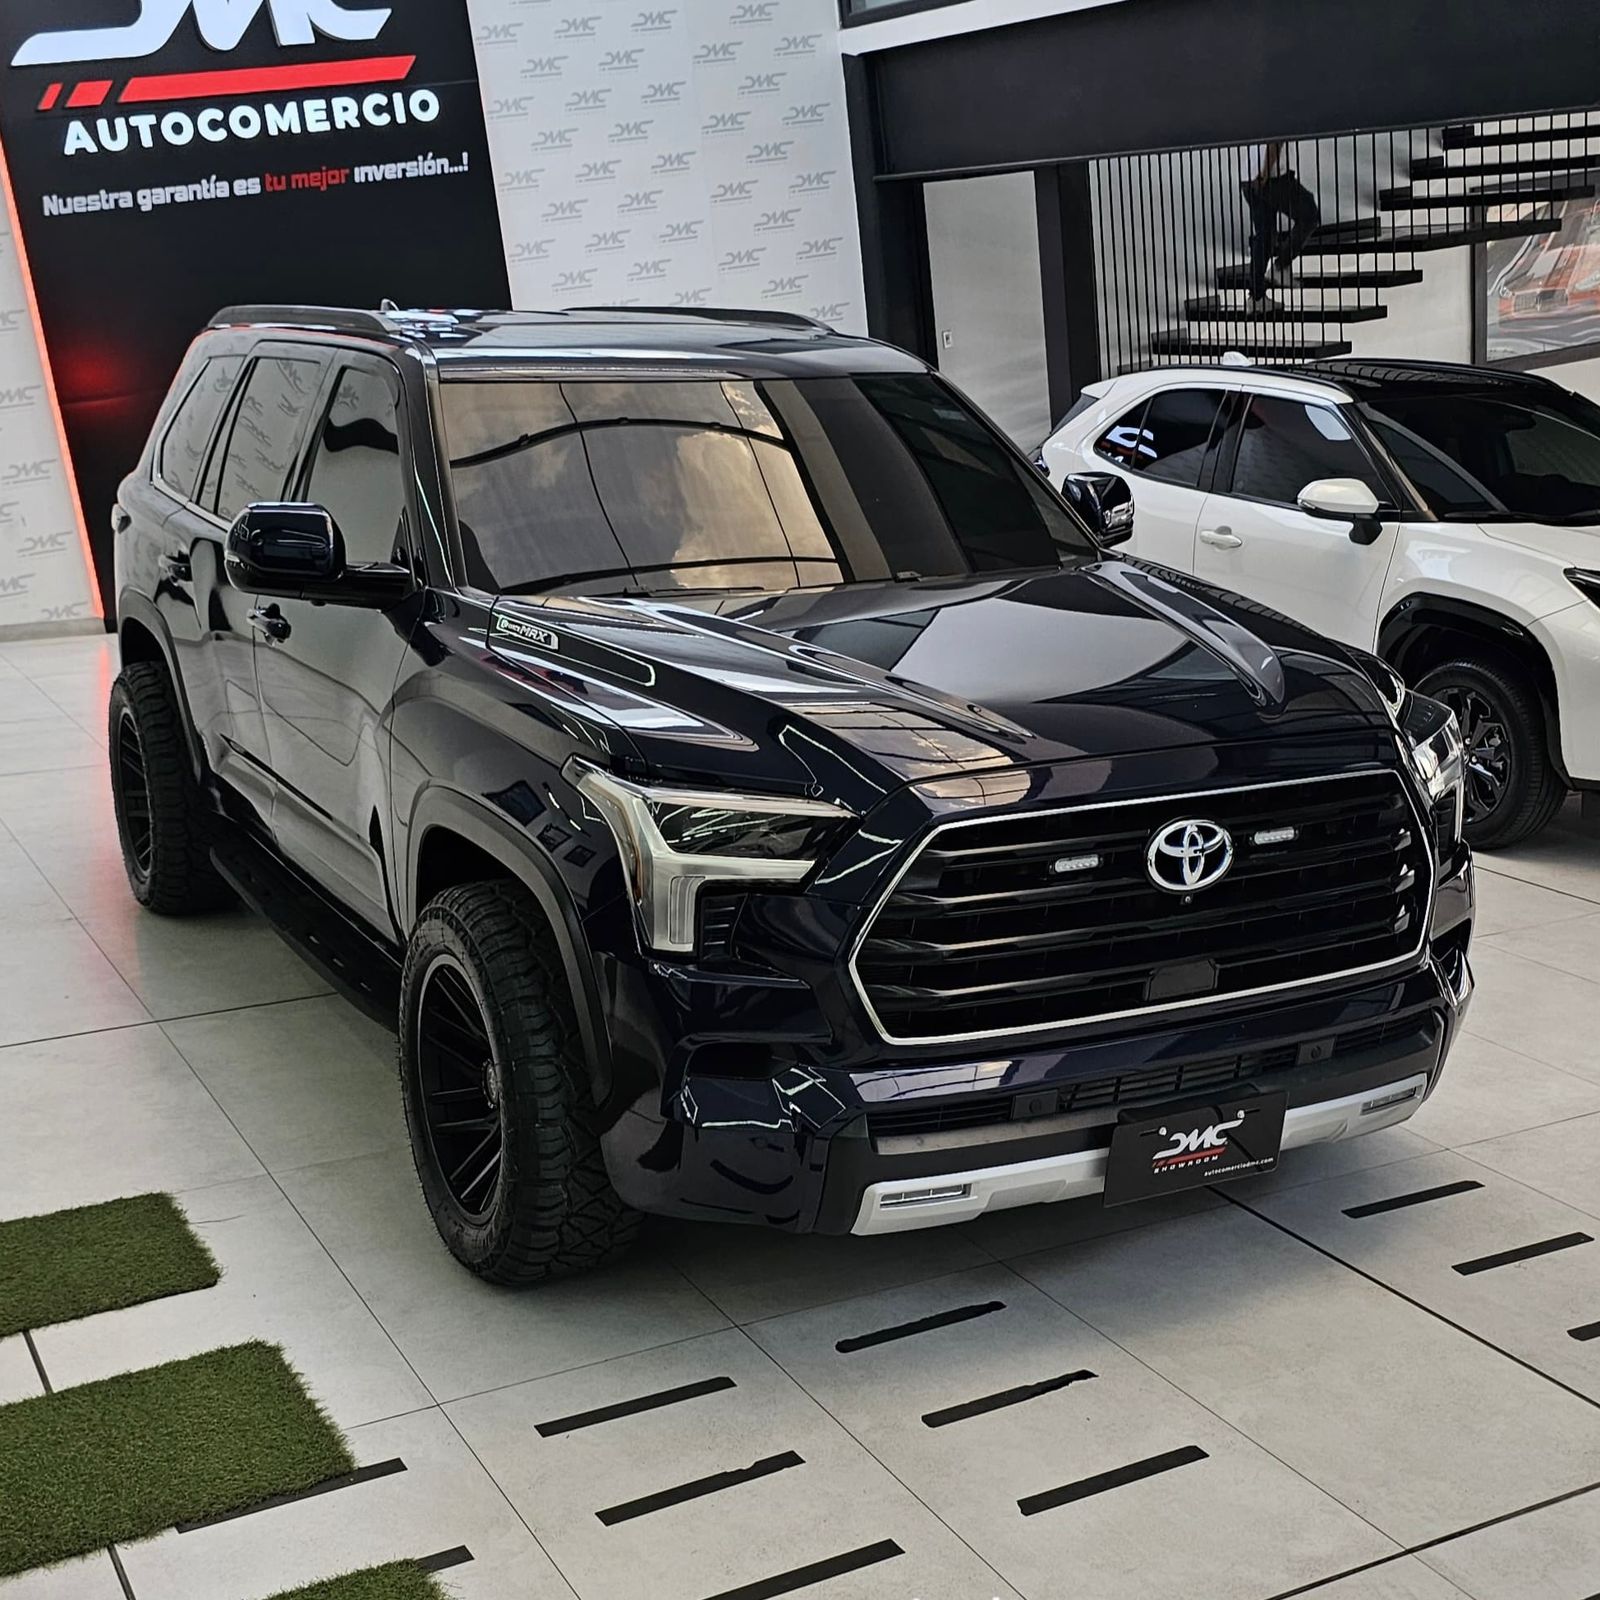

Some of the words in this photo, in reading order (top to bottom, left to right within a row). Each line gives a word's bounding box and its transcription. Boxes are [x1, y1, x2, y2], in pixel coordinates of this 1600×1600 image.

[63, 88, 440, 156] AUTOCOMERCIO
[42, 188, 134, 217] Nuestra
[136, 174, 230, 212] garantía
[233, 177, 261, 196] es
[264, 172, 287, 192] tu
[291, 166, 349, 192] mejor
[1152, 1119, 1244, 1160] DMC
[1153, 1155, 1219, 1174] SHOWROOM
[1203, 1157, 1275, 1177] autocomerciodmc.com
